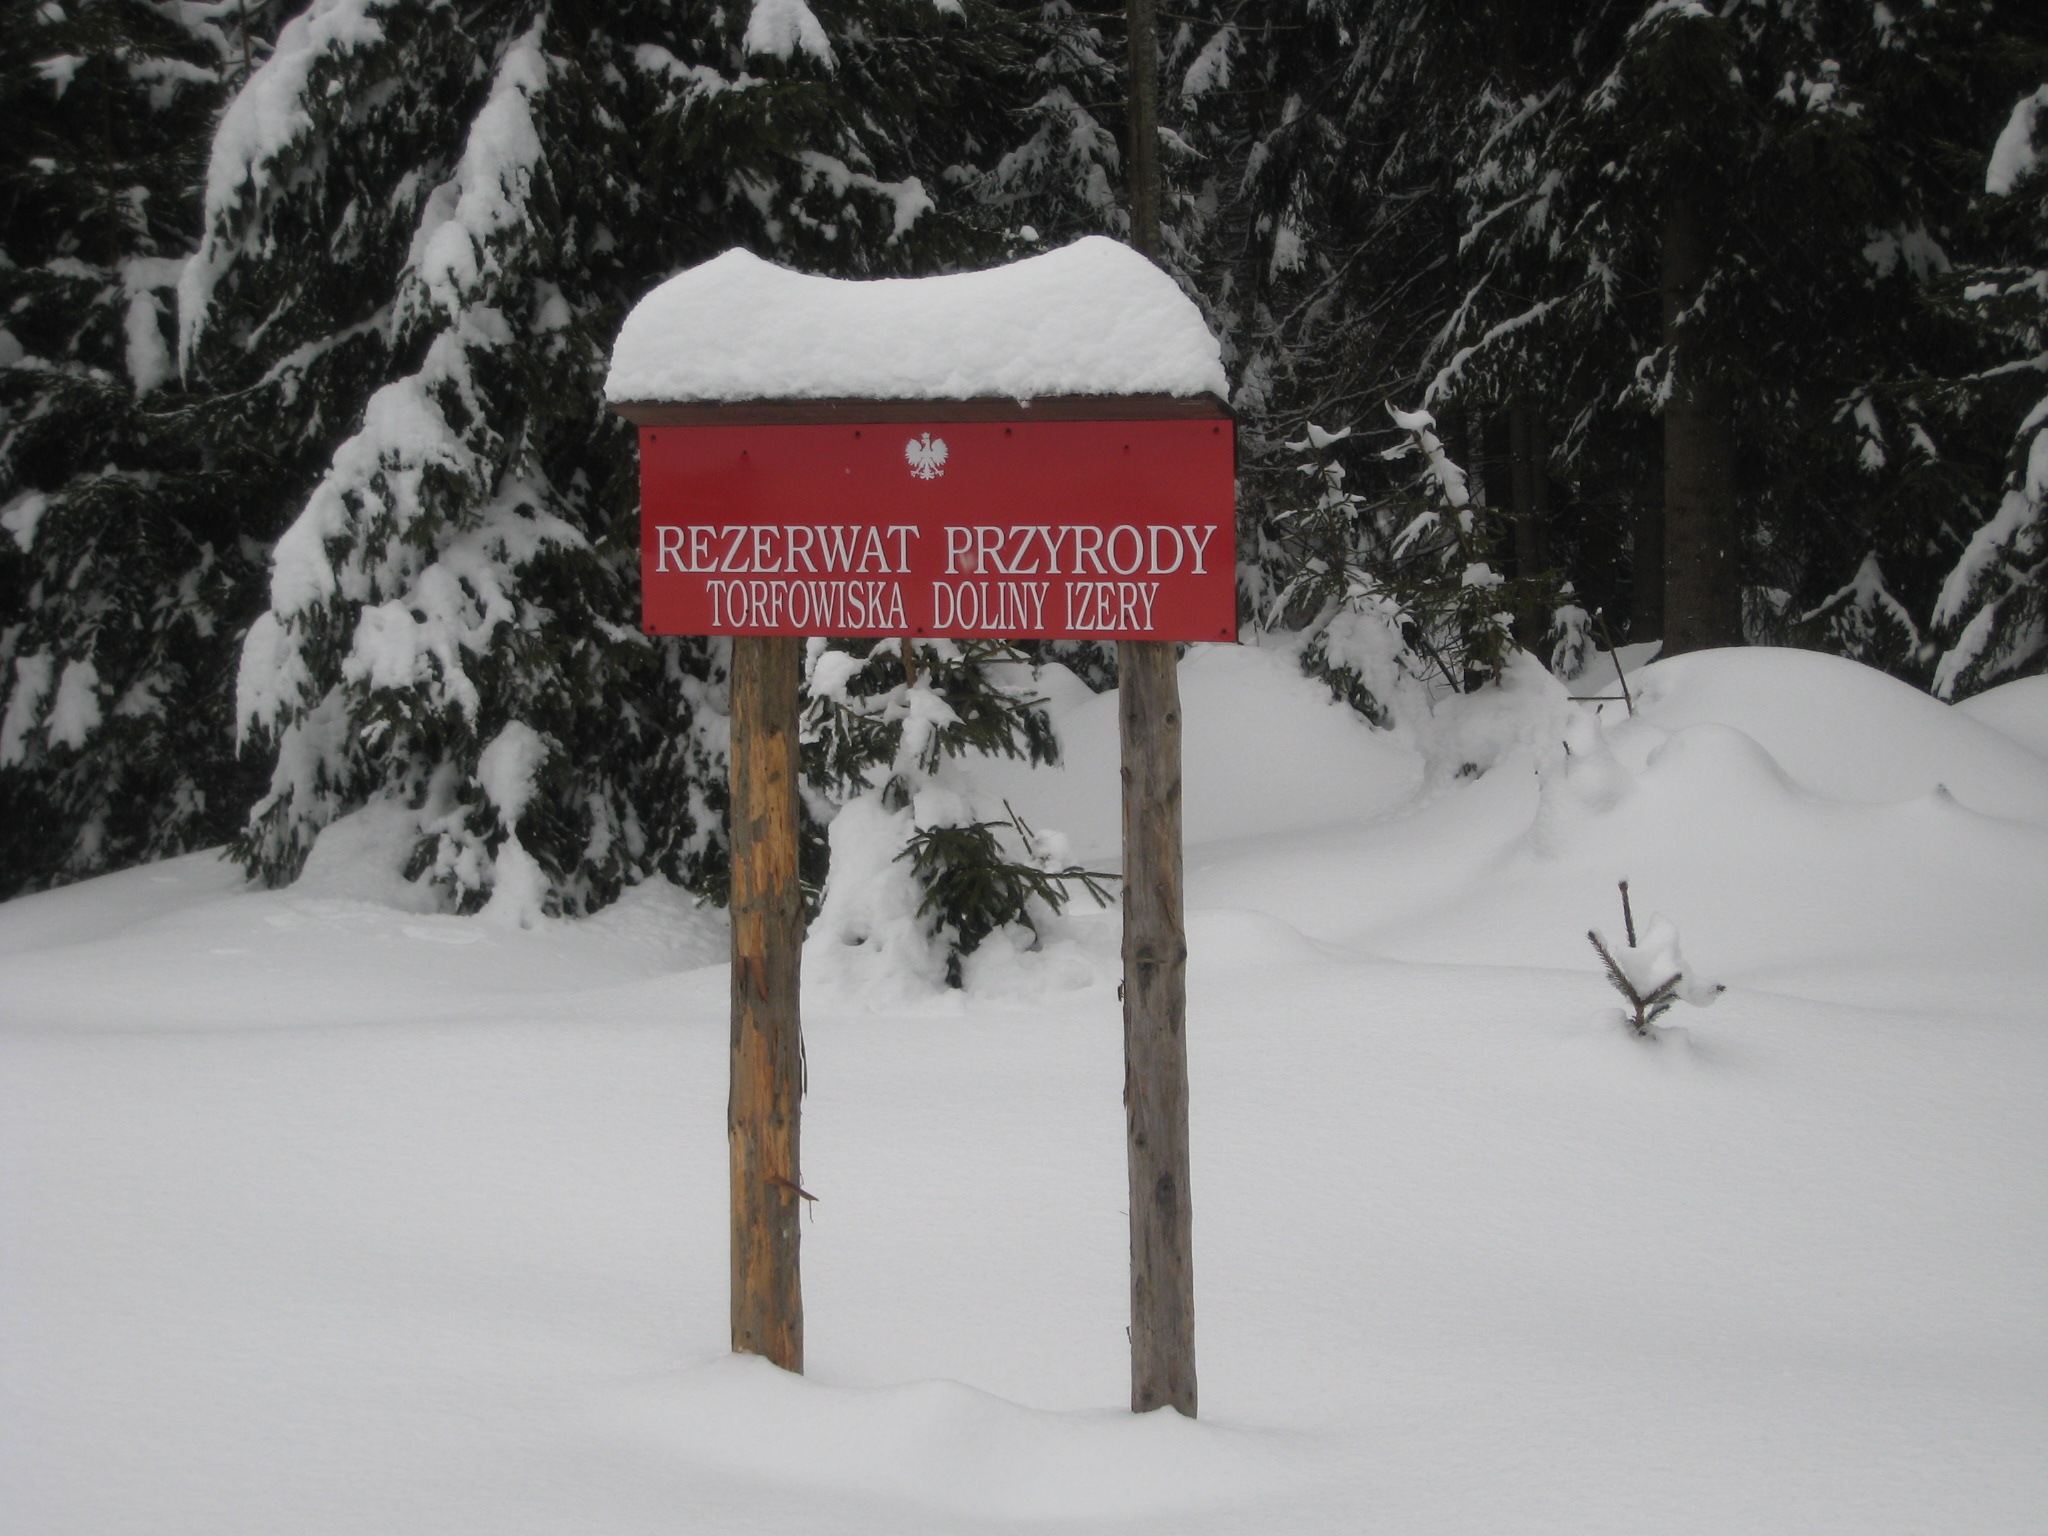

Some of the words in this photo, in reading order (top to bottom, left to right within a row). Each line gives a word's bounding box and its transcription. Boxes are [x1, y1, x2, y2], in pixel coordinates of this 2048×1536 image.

[655, 525, 920, 574] REZERWAT
[944, 525, 1217, 575] PRZYRODY
[707, 580, 909, 630] TORFOWISKA
[933, 581, 1050, 631] DOLINY
[1065, 582, 1160, 631] IZERY
